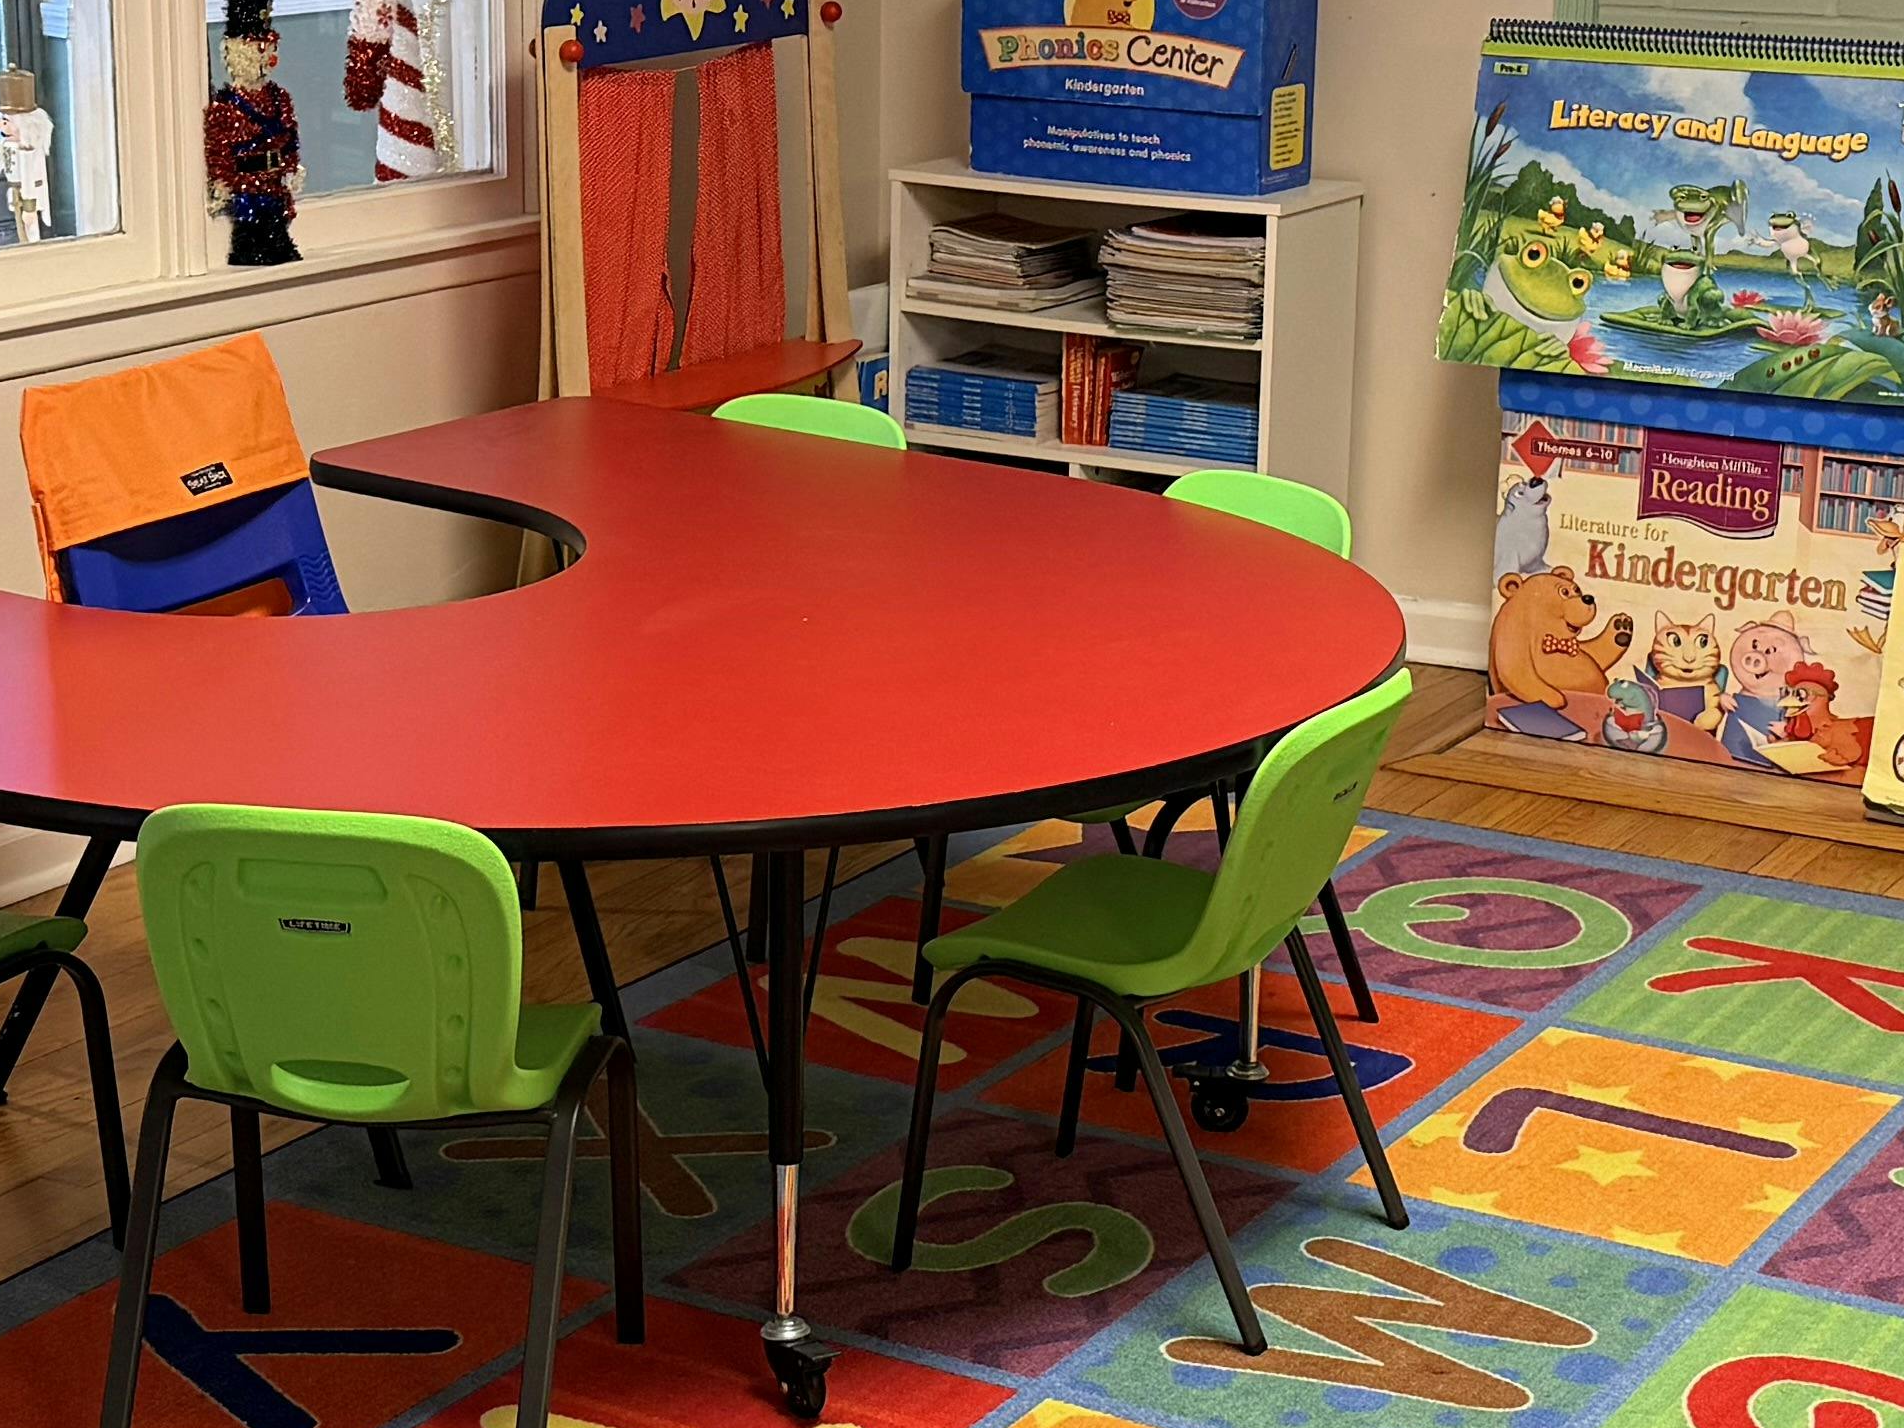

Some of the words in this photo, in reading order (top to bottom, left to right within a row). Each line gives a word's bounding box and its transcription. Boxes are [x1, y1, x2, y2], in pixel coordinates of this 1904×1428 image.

[997, 31, 1120, 62] Phonics
[1127, 34, 1224, 80] Center
[1065, 78, 1145, 97] Kindergarten
[1549, 99, 1669, 141] Literacy
[1672, 115, 1726, 145] and
[1731, 116, 1869, 162] Language
[1650, 468, 1772, 522] Reading
[1560, 513, 1640, 539] Literature
[1643, 523, 1670, 543] for
[1585, 538, 1848, 612] Kindergarten
[1461, 1084, 1807, 1176] L
